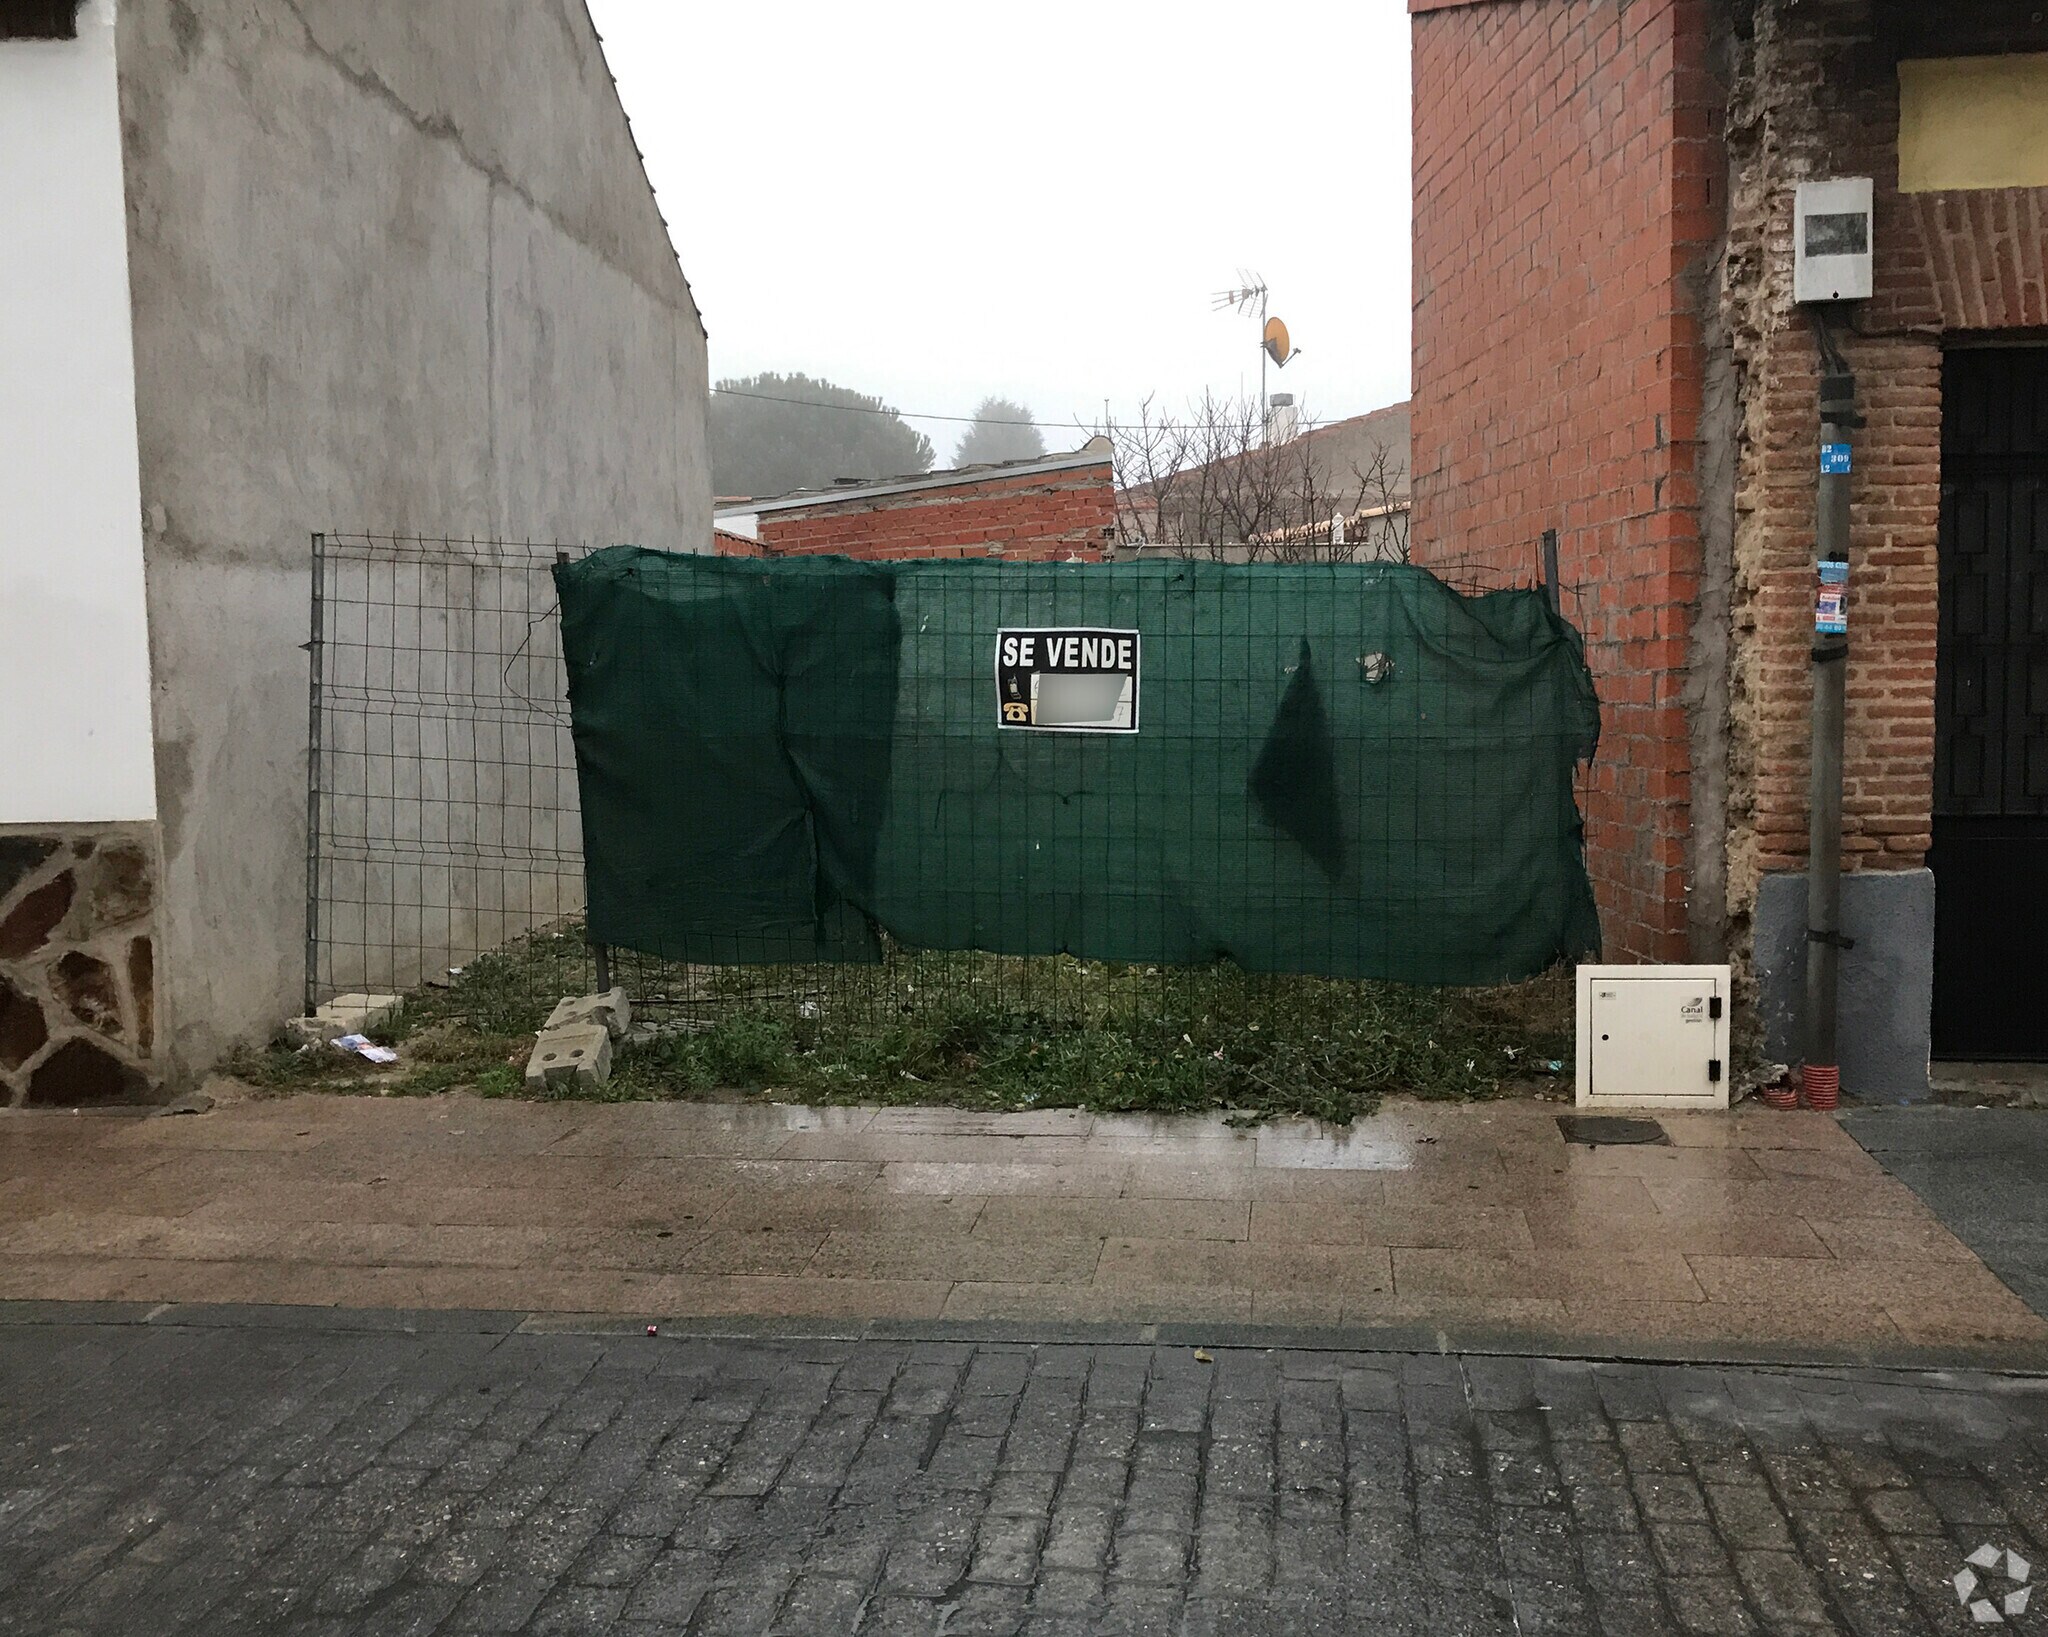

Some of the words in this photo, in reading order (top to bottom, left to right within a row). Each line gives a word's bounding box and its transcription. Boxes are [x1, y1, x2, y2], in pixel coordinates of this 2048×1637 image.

[1002, 637, 1035, 667] SE
[1046, 637, 1132, 669] VENDE
[1681, 1006, 1703, 1014] Canal
